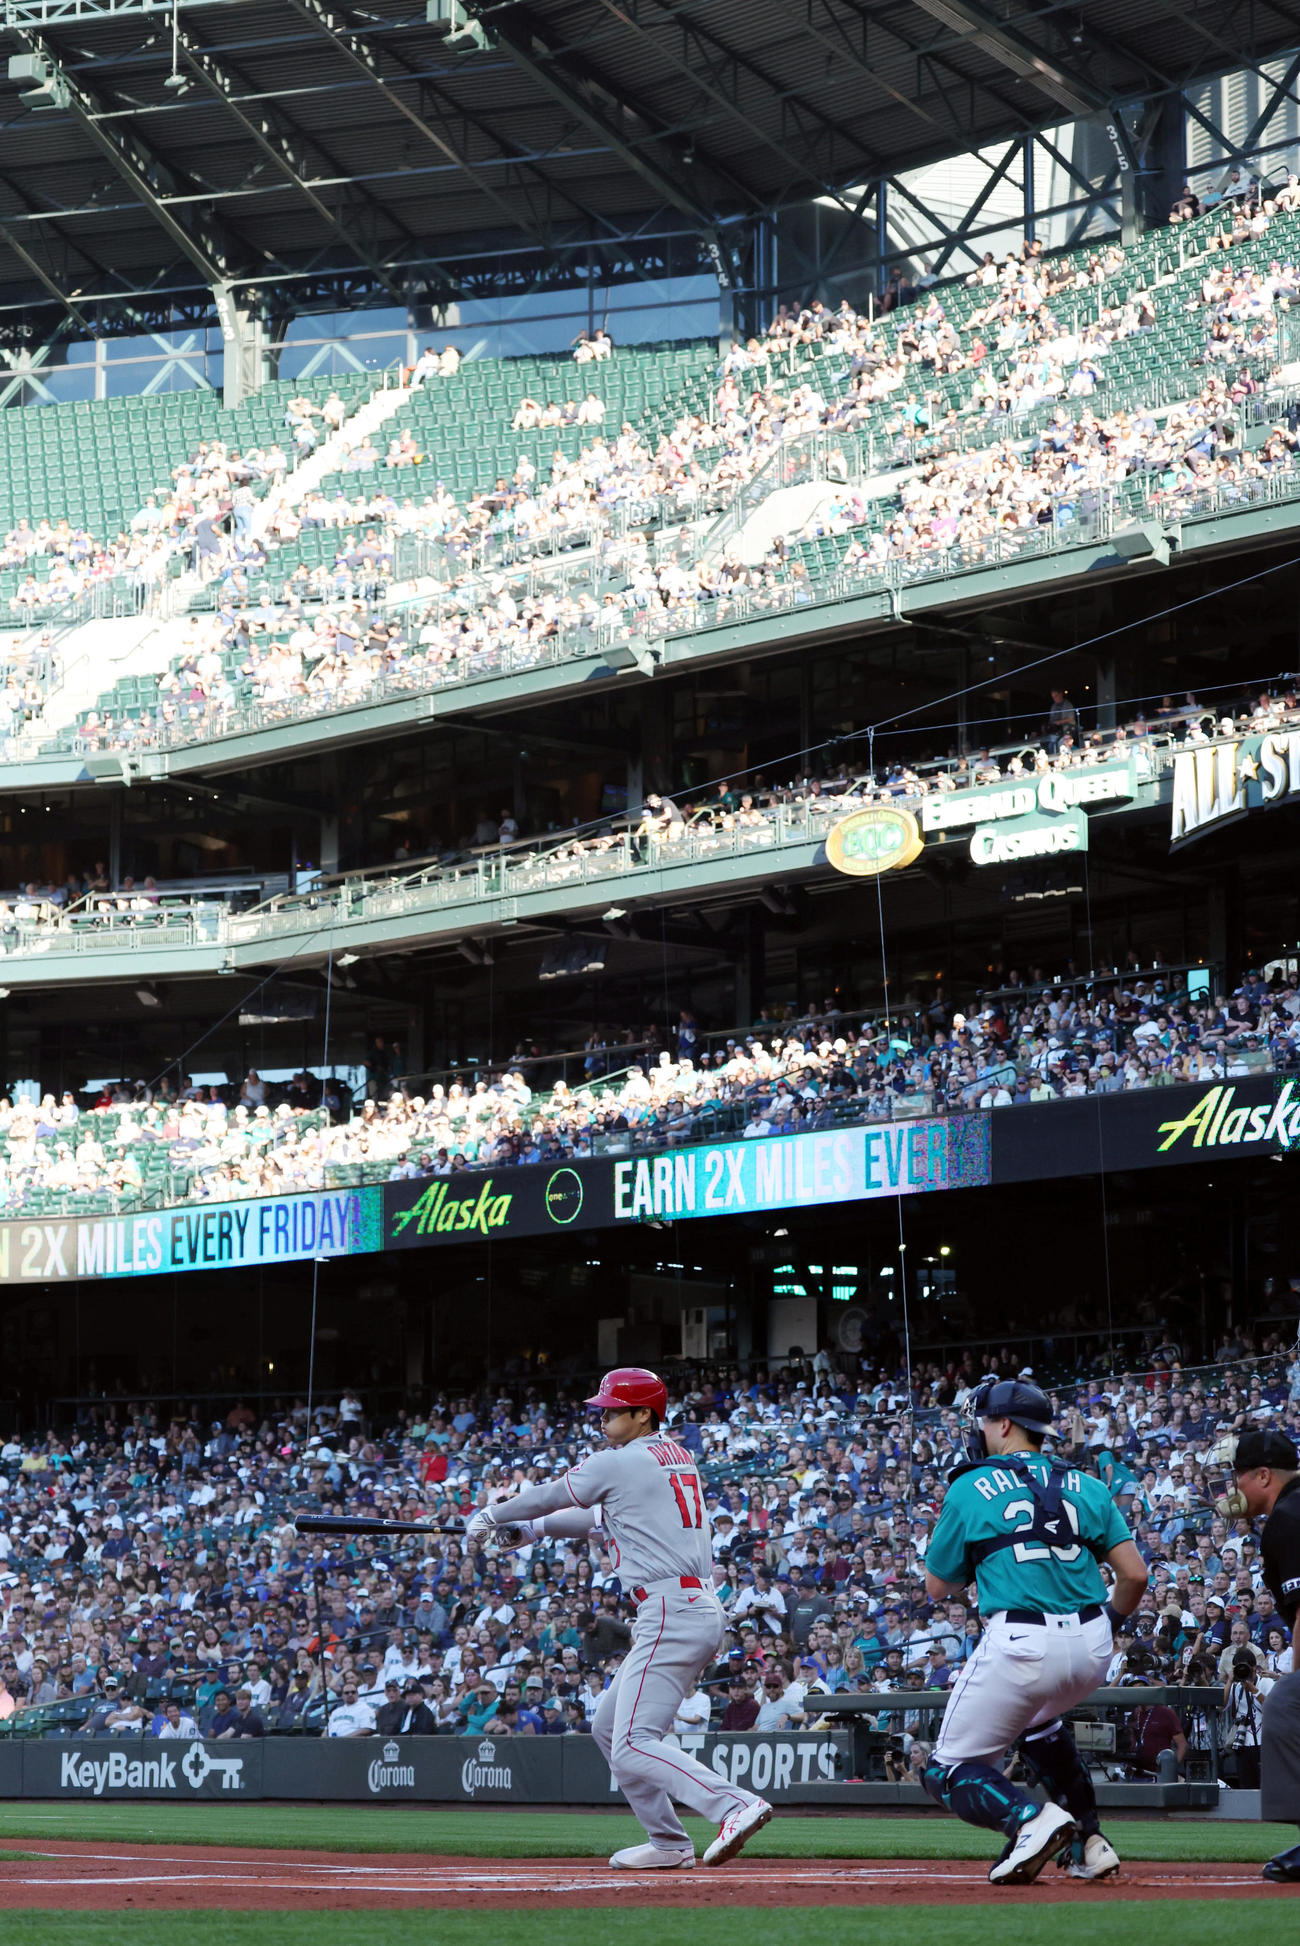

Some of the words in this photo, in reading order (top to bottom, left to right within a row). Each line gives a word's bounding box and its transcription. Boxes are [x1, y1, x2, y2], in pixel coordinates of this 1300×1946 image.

[1106, 125, 1129, 171] 315
[708, 243, 729, 287] 314
[217, 297, 235, 341] 313
[1171, 742, 1246, 843] ALL
[614, 1154, 696, 1219] EARN
[704, 1147, 747, 1208] 2X
[755, 1133, 852, 1202] MILES
[392, 1179, 513, 1236] Alaska
[20, 1225, 68, 1278] 2X
[77, 1217, 163, 1277] MILES
[171, 1208, 250, 1265] EVERY
[668, 1473, 702, 1529] 17
[61, 1752, 176, 1795] KeyBank
[368, 1759, 415, 1793] Corona
[461, 1757, 512, 1797] Corona
[712, 1742, 839, 1791] SPORTS
